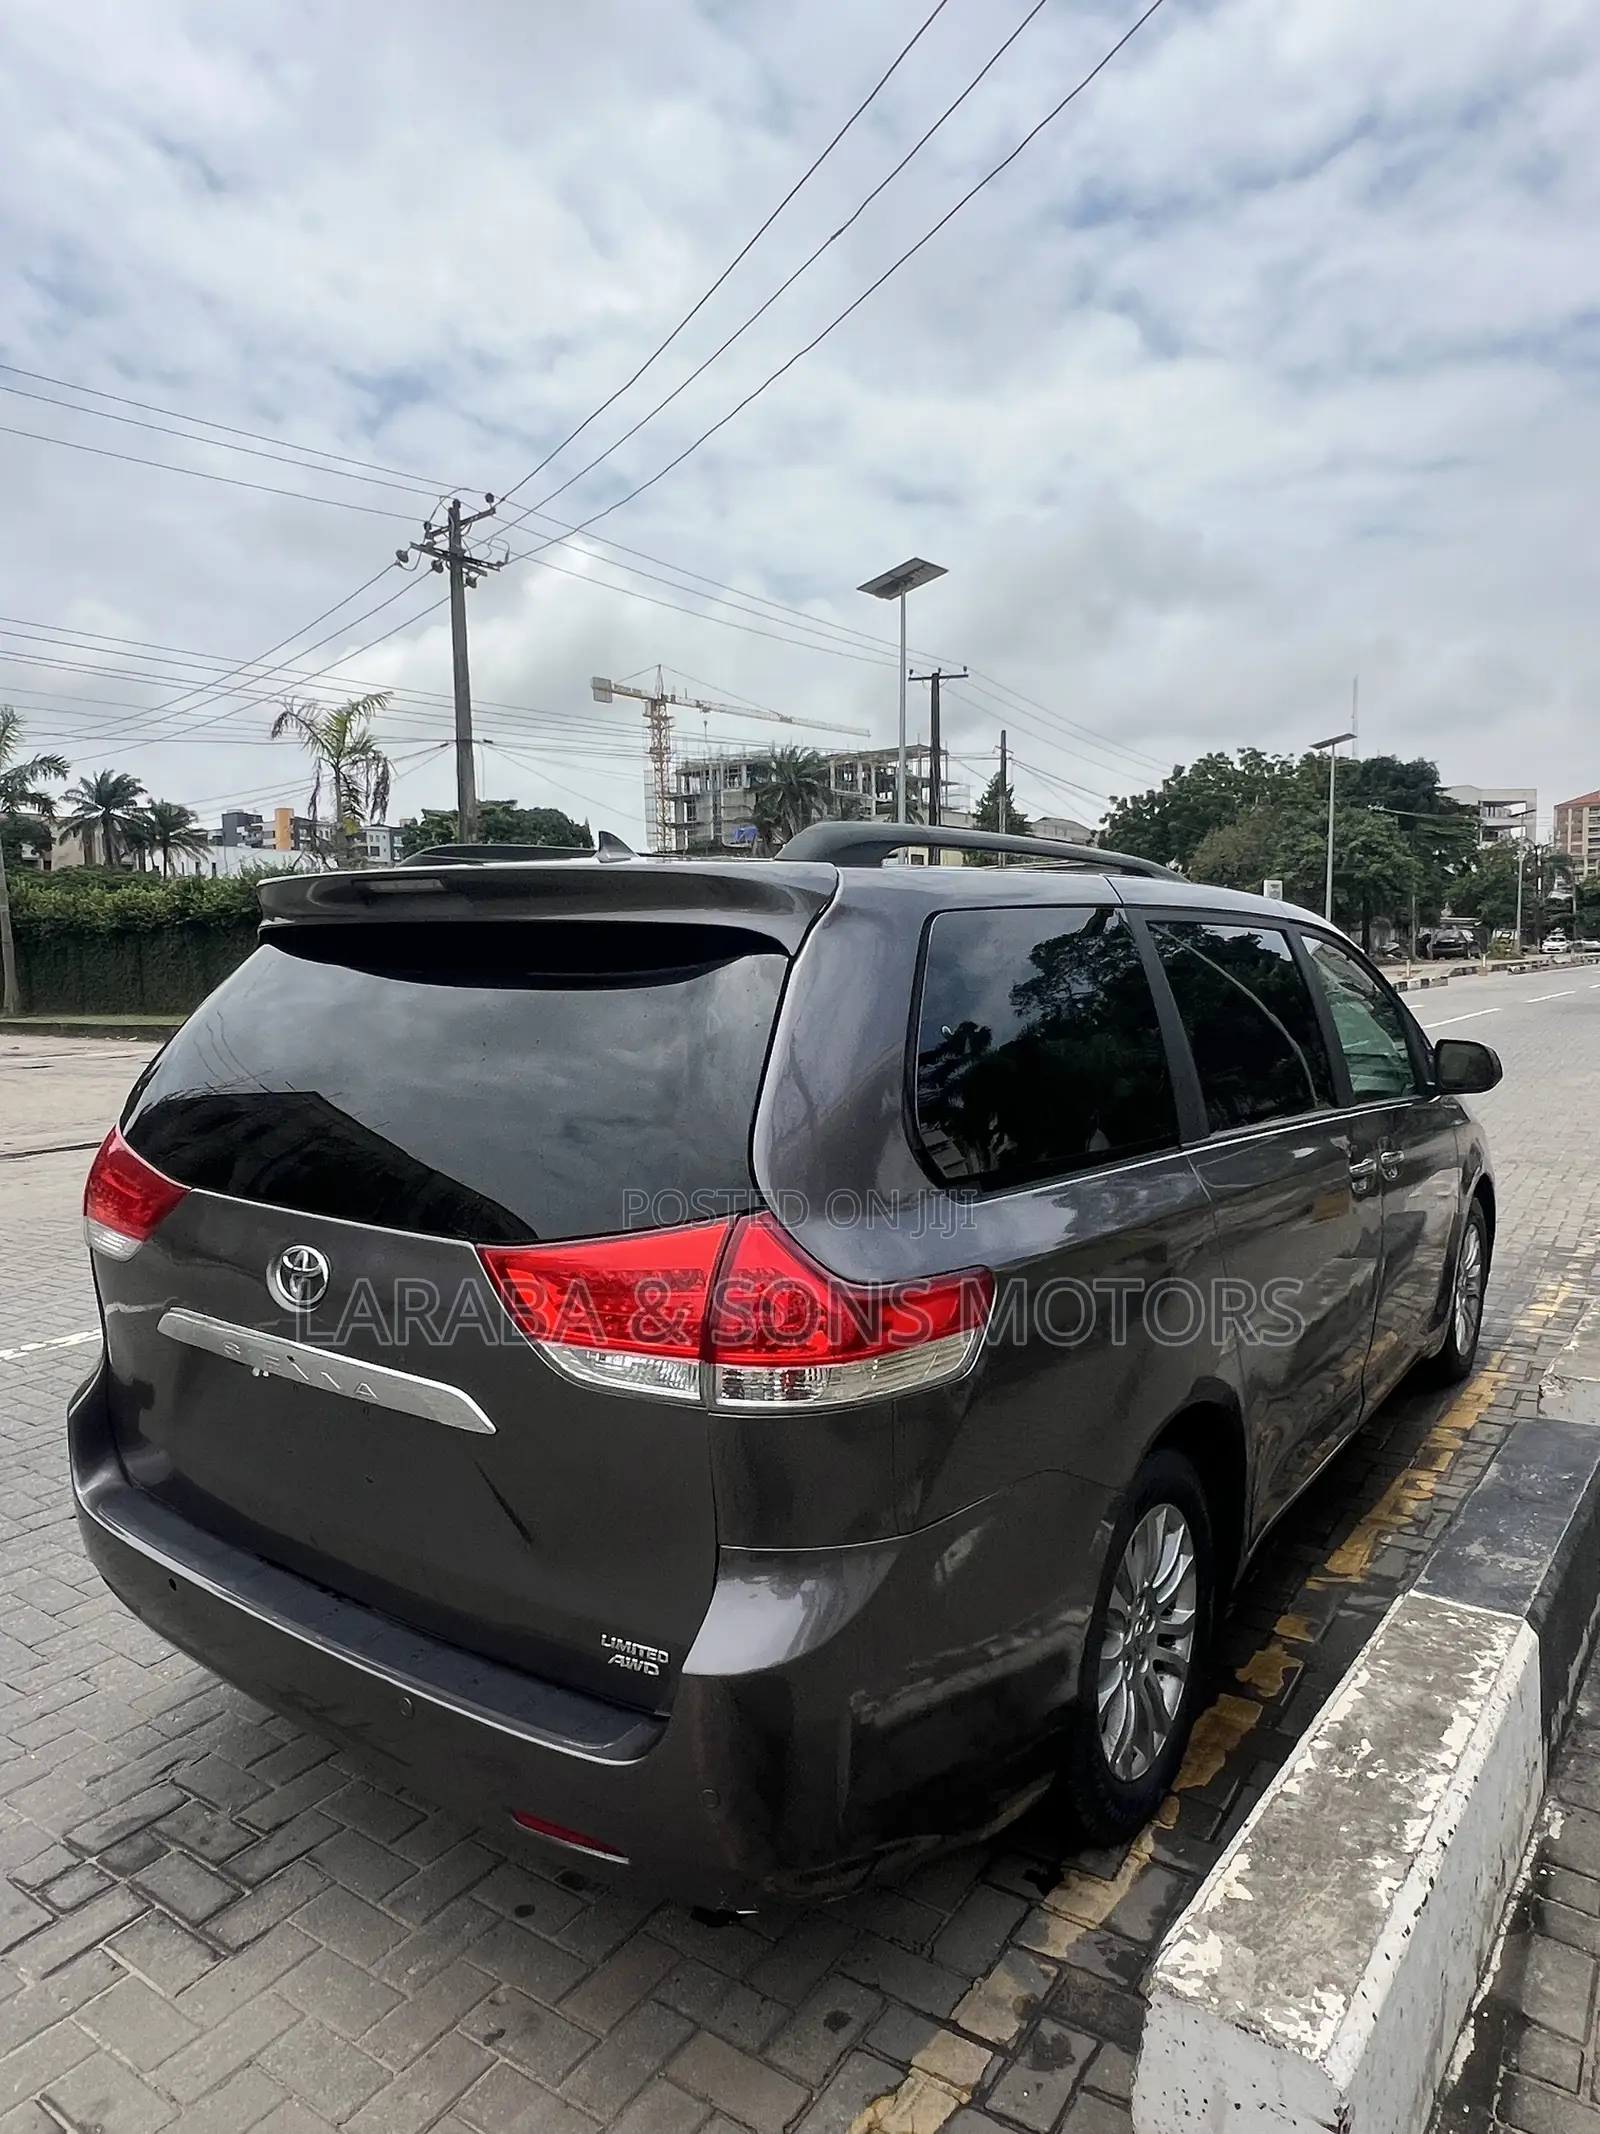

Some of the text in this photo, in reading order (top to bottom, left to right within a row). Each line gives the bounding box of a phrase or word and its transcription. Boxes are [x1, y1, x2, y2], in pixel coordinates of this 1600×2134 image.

[221, 1340, 381, 1401] SEA
[601, 1633, 669, 1663] LIMITED
[608, 1654, 660, 1676] AWD
